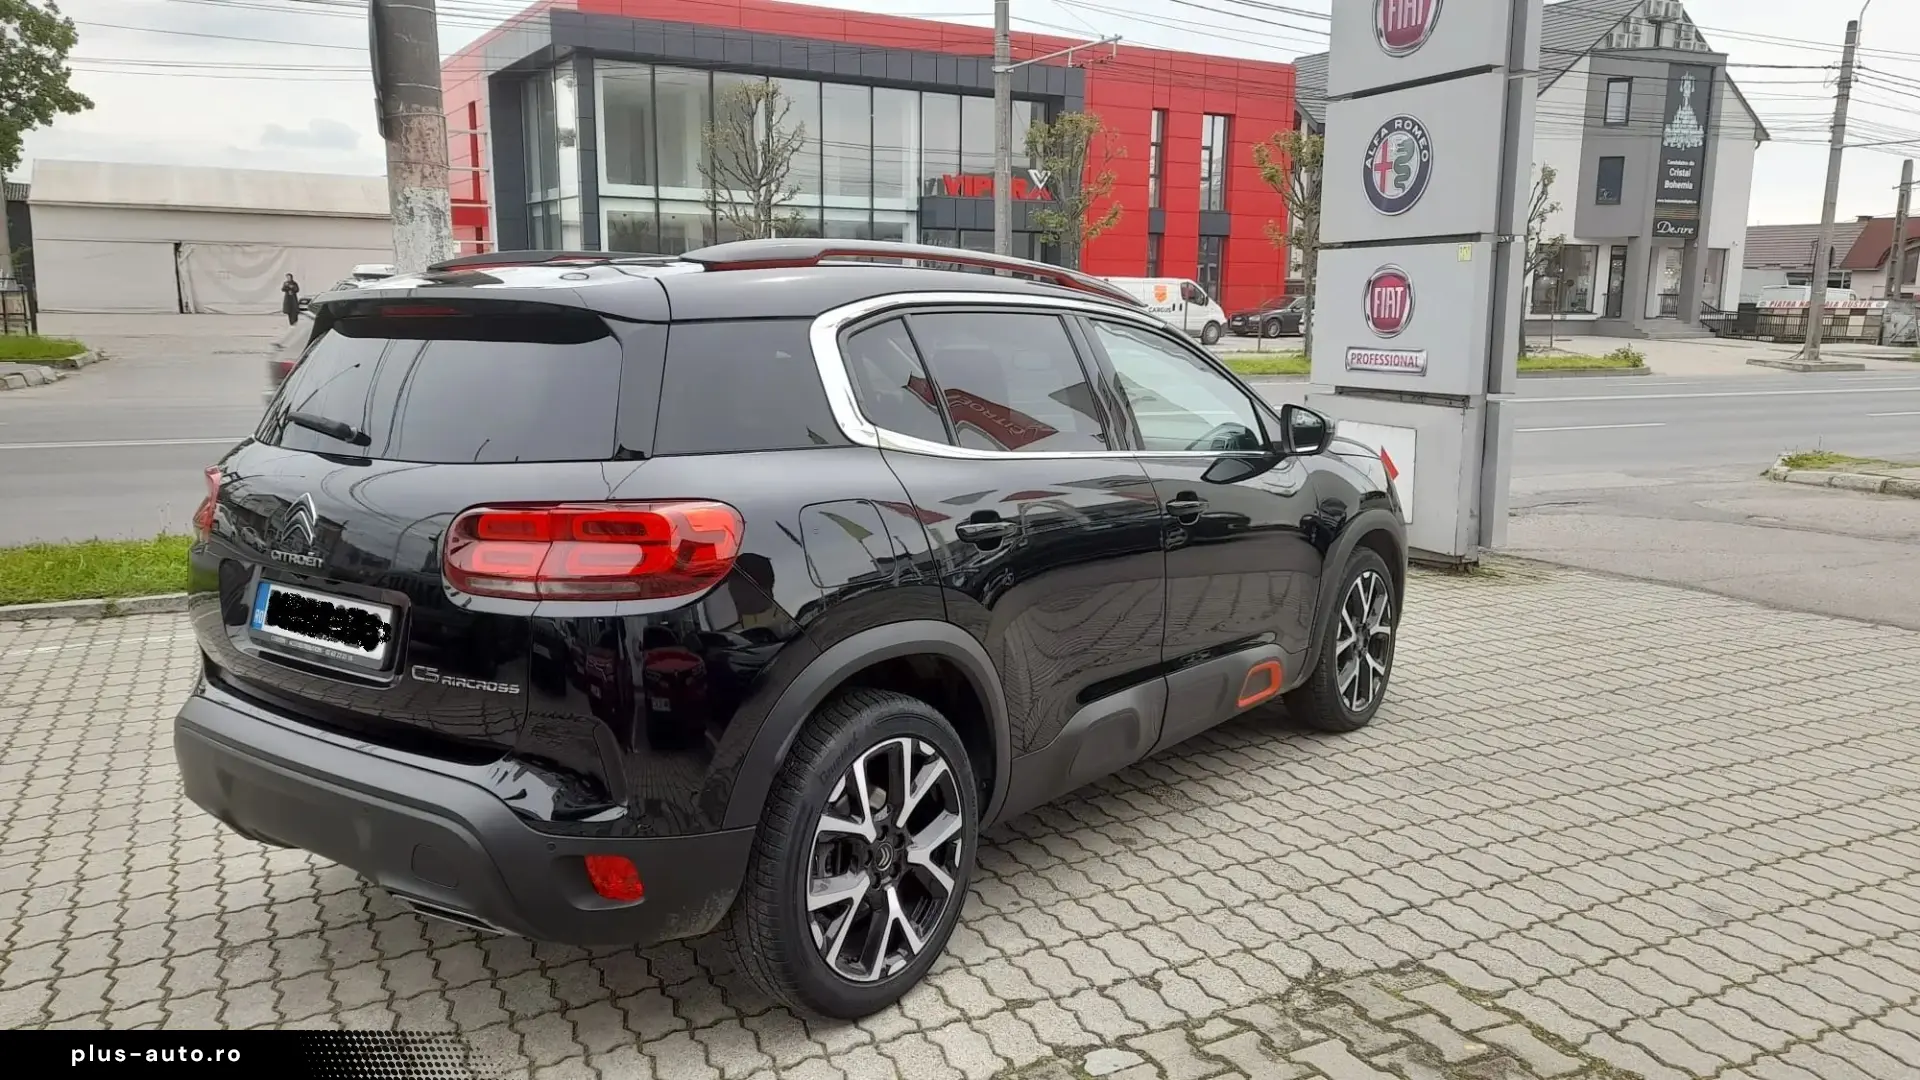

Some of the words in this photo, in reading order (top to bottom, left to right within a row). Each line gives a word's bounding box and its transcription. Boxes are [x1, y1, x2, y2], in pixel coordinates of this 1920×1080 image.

[1365, 127, 1389, 169] ALFA
[1394, 119, 1429, 162] ROMEO
[1669, 167, 1692, 177] Cristal
[1664, 180, 1693, 189] Bohemia
[1657, 220, 1694, 234] Desire
[1373, 286, 1404, 319] FIAT
[1350, 351, 1421, 368] PROFESSIONAL
[411, 664, 440, 684] C5
[441, 675, 520, 694] AIRCROSS
